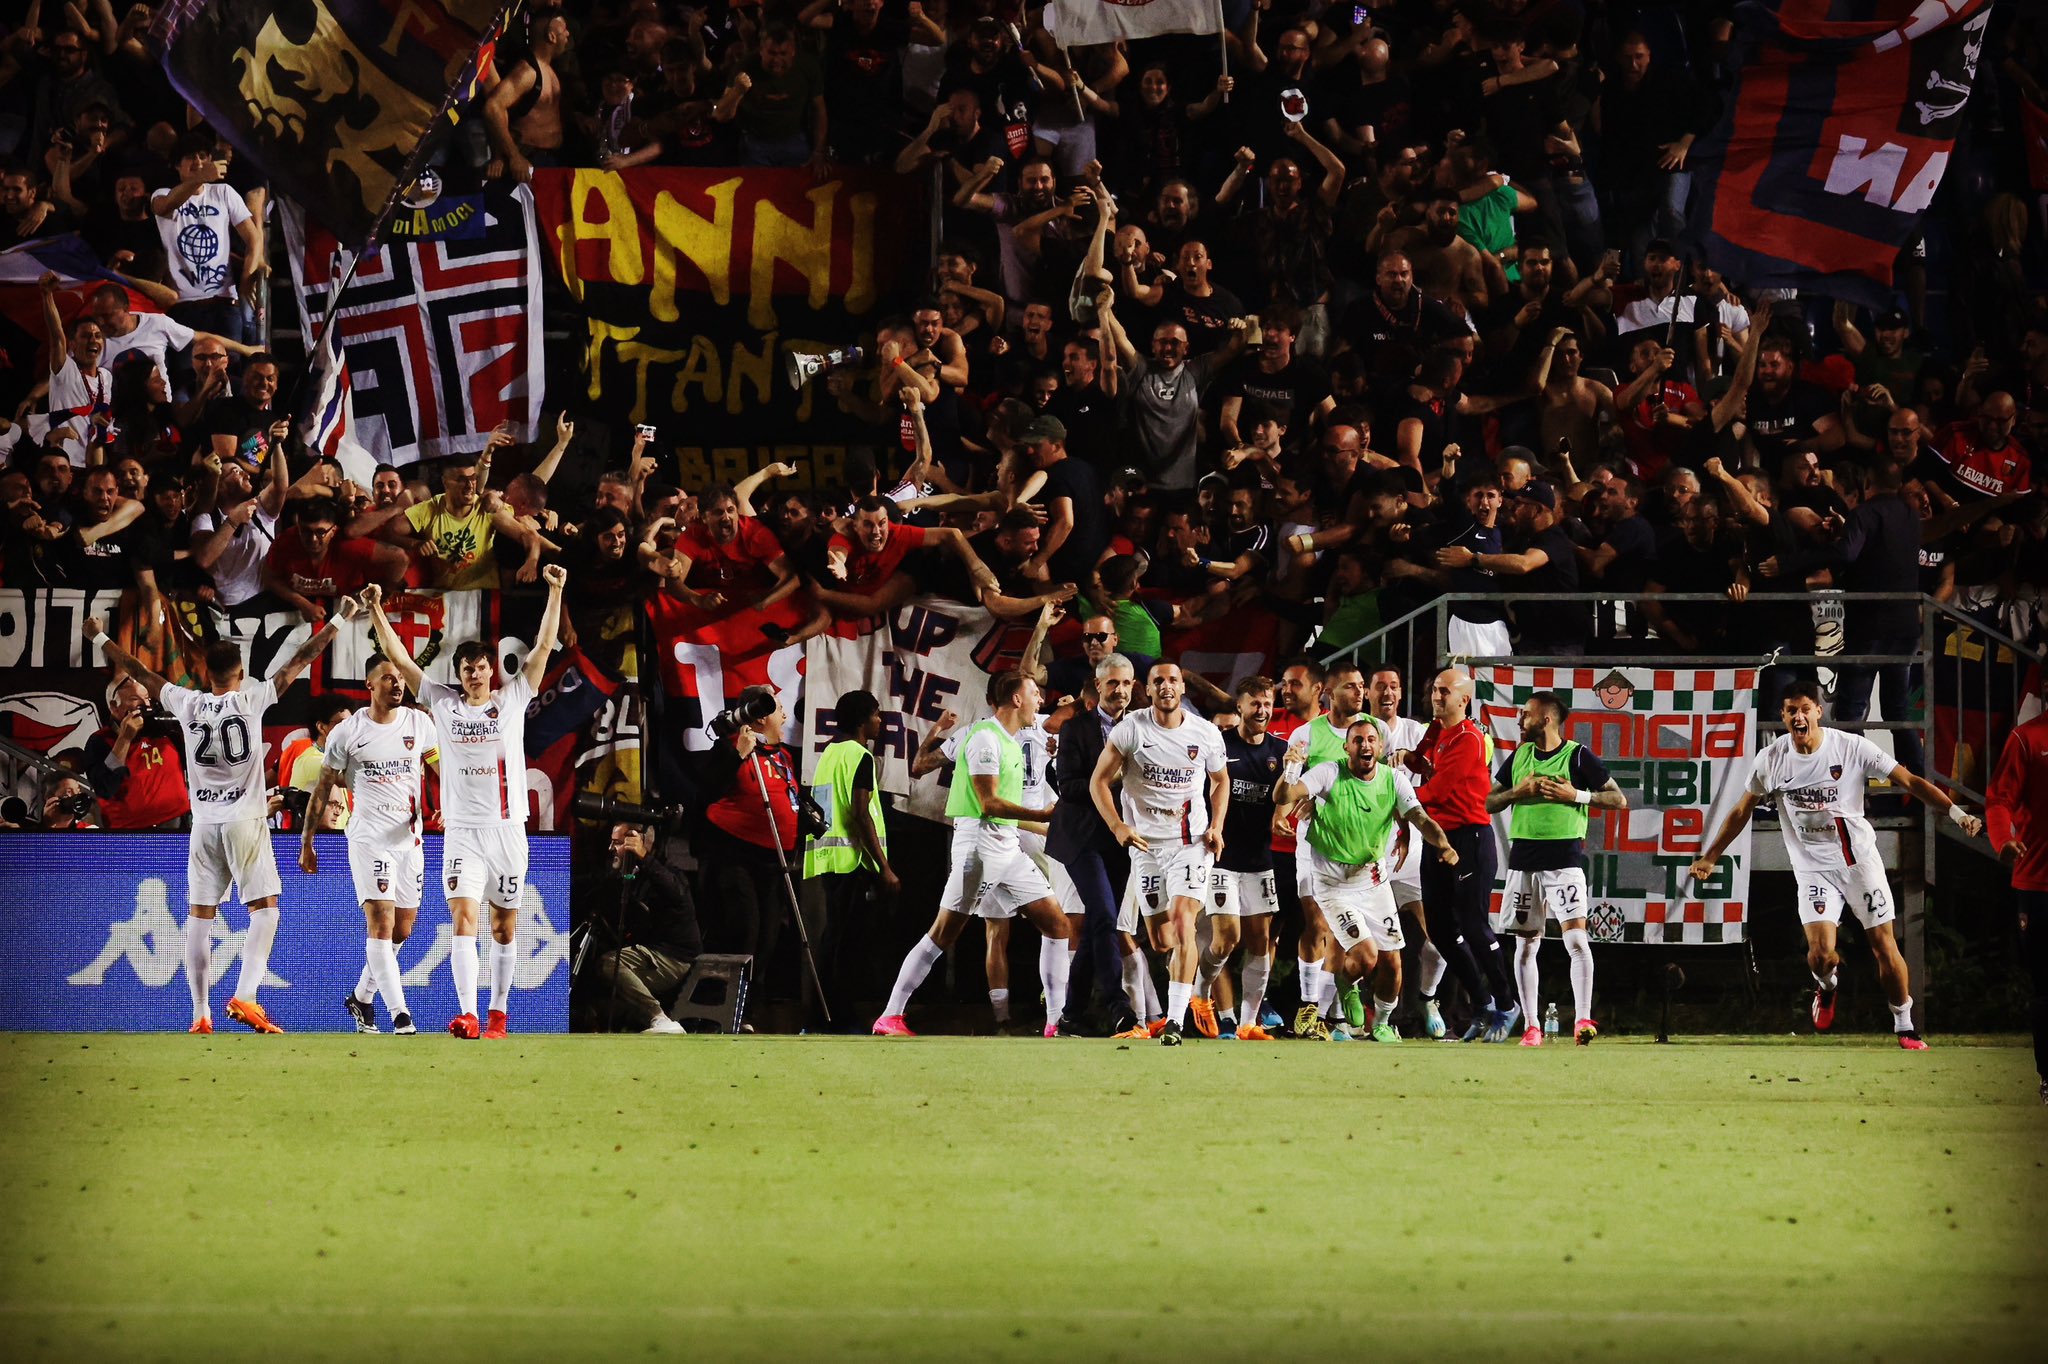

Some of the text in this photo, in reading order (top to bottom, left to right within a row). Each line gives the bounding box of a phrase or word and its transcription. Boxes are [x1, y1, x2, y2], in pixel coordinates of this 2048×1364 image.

[392, 201, 476, 235] DIAMOCI
[556, 167, 877, 331] ANNI
[889, 605, 960, 656] UP
[451, 720, 485, 729] SALUMI
[451, 727, 500, 736] CALABRIA
[187, 714, 253, 767] 20
[363, 761, 399, 770] SALUMI
[1143, 764, 1181, 776] SALUMI
[1142, 772, 1192, 783] CALABRIA
[498, 874, 518, 894] 15
[1556, 884, 1580, 907] 32
[1863, 888, 1887, 913] 23
